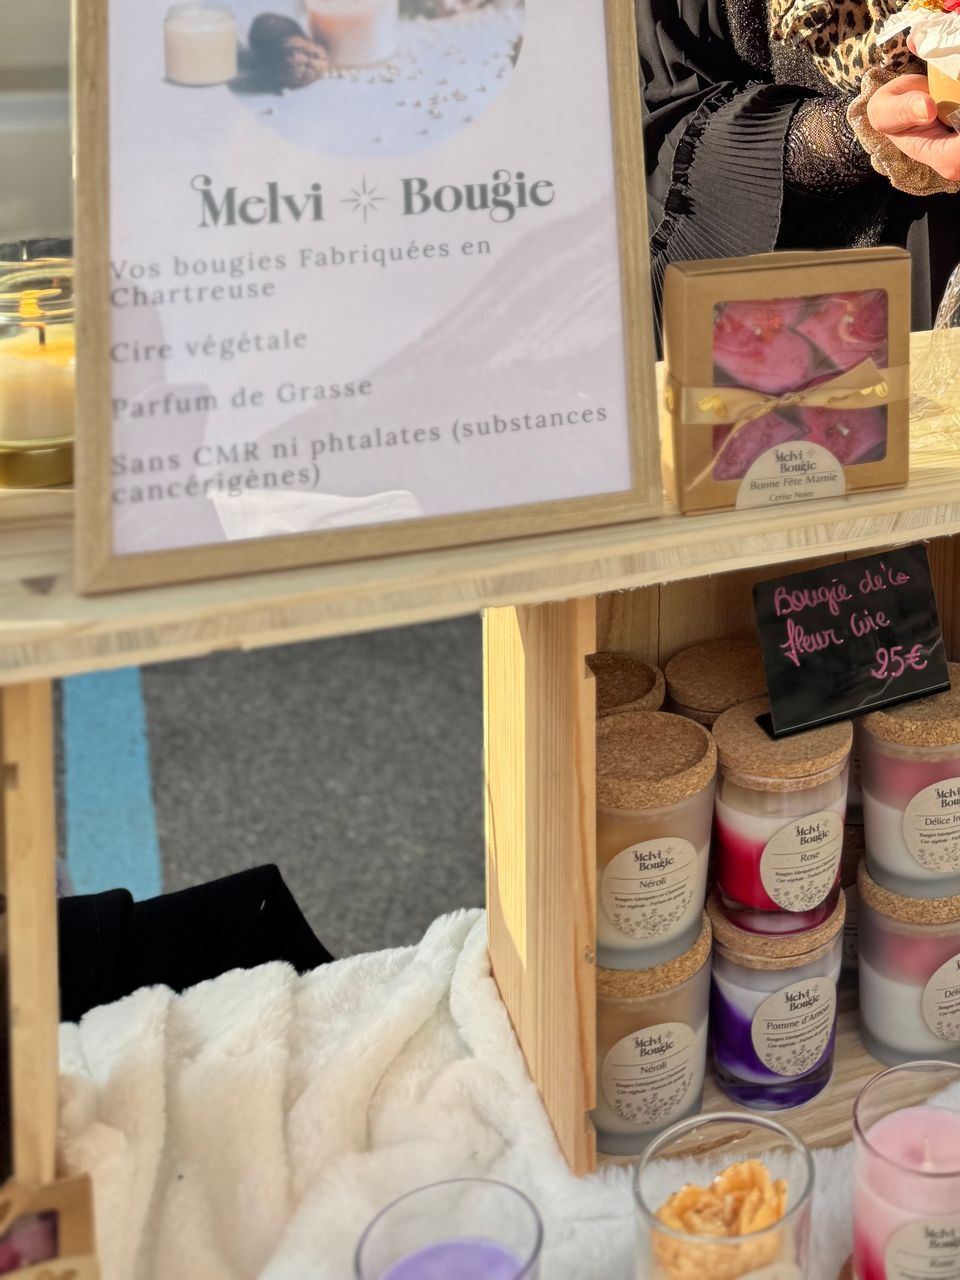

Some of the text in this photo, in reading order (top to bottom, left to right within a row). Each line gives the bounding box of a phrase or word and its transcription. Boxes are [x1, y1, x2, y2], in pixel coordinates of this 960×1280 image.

[190, 169, 555, 227] Melvi Bougie
[110, 239, 492, 281] Vos bougies Fabriquées en
[110, 281, 277, 308] Chartreuse
[110, 329, 308, 364] Cire végétale
[111, 379, 373, 420] Parfum de Grasse
[111, 407, 608, 477] Sans CMR ni phtalates (substances
[111, 463, 321, 505] cancérigènes)
[750, 480, 780, 490] Bonne
[806, 473, 837, 484] Mamie
[774, 578, 853, 616] Bougie
[780, 617, 844, 667] fleur
[871, 643, 928, 679] 25€
[925, 817, 951, 826] Délice
[801, 852, 820, 862] Rose
[640, 877, 666, 888] Néroli
[767, 1020, 800, 1030] Pomme
[640, 1061, 667, 1074] Néroli
